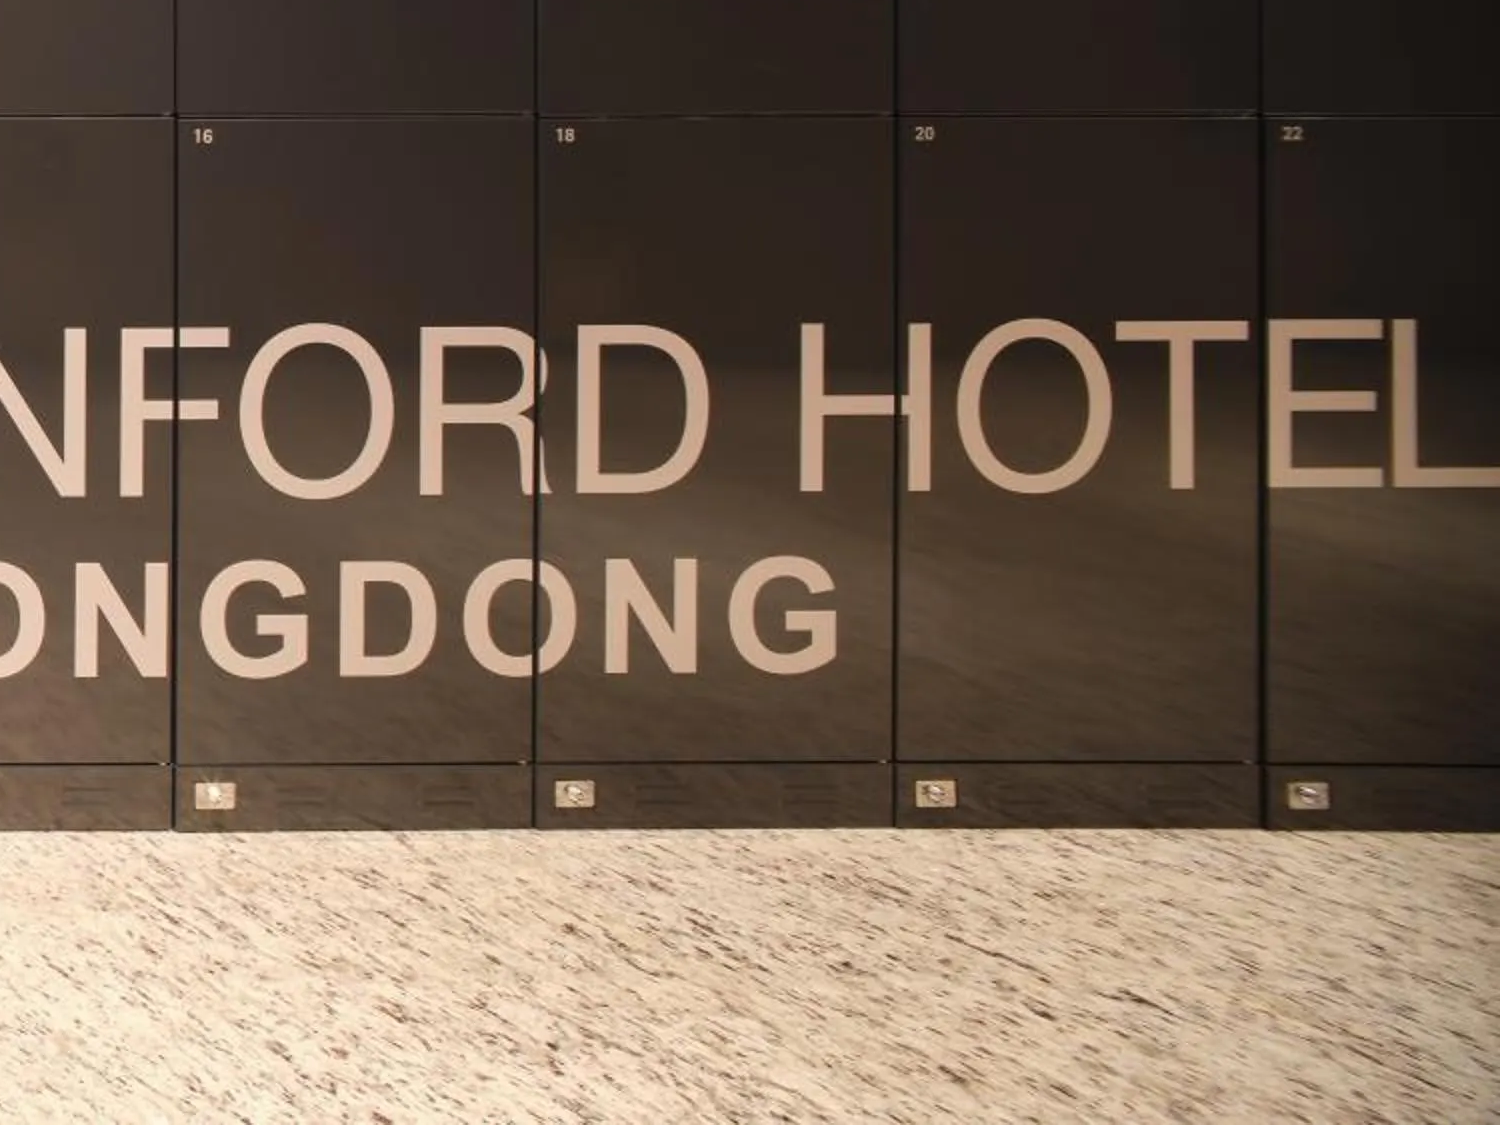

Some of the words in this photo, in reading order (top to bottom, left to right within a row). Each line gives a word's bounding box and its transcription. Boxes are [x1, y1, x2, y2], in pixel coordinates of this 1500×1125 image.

[194, 128, 213, 144] 16
[556, 128, 575, 143] 18
[915, 126, 935, 141] 20
[1282, 126, 1304, 142] 22
[799, 318, 1500, 494] HOTEL
